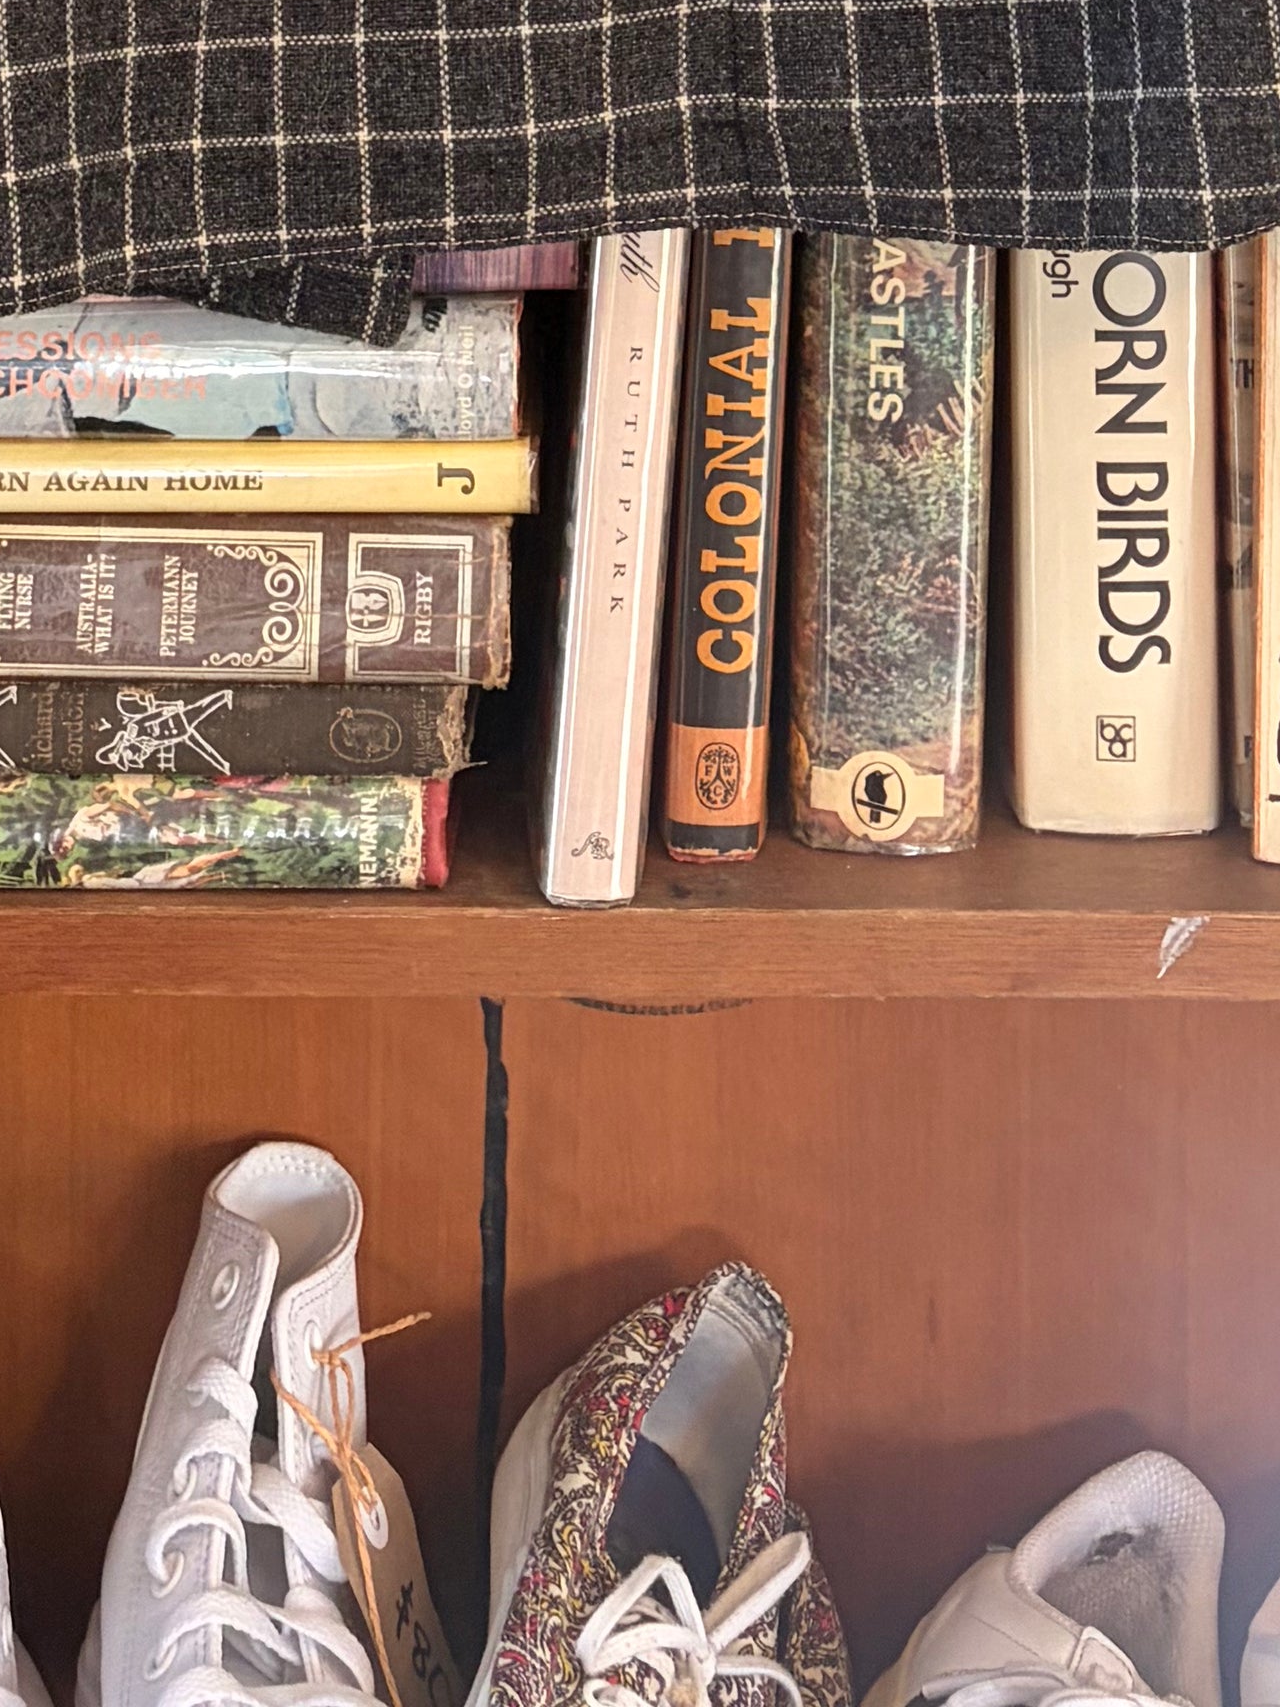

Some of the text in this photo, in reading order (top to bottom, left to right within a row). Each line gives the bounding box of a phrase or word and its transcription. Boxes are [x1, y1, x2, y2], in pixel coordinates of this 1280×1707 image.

[43, 470, 149, 493] AGAIN
[163, 468, 265, 494] HOME
[436, 461, 476, 496] J
[608, 344, 645, 614] RUTH PARK
[695, 294, 776, 677] COLONIAL
[160, 554, 181, 658] PETERMANN
[179, 568, 200, 646] JOURNEY
[414, 570, 436, 646] RIGBY
[1095, 460, 1173, 677] BIRDS
